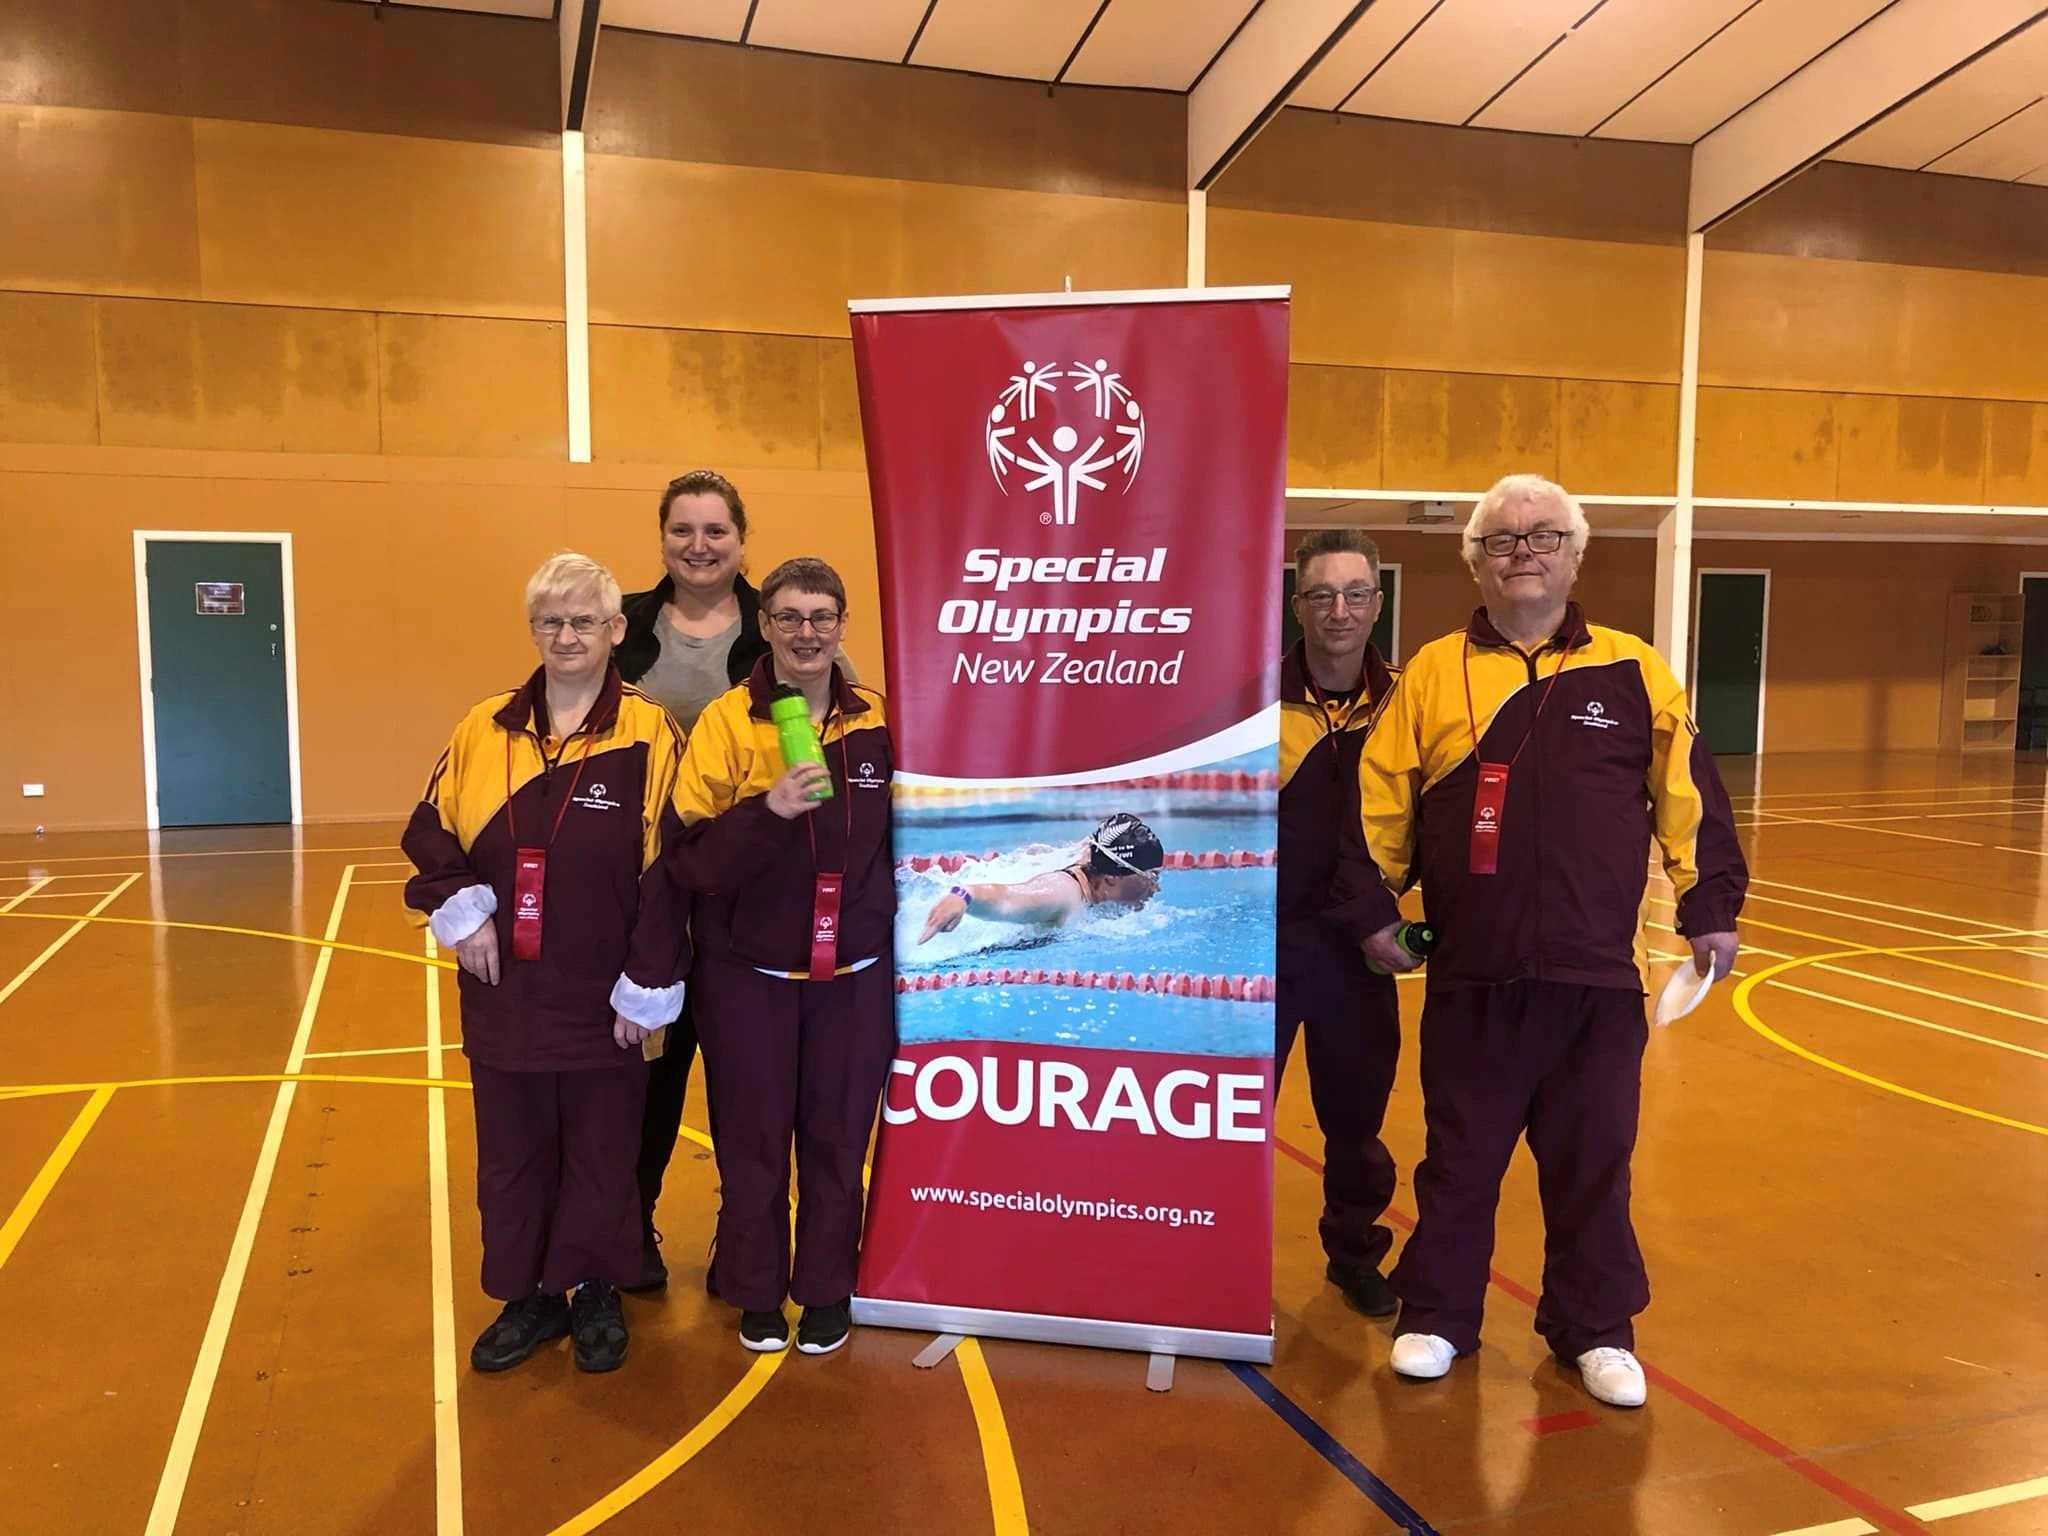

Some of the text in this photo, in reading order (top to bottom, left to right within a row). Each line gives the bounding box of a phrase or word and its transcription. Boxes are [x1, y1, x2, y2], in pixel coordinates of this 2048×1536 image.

[962, 547, 1168, 591] Special
[937, 599, 1193, 642] Olympics
[952, 650, 1185, 685] New Zealand
[882, 1055, 1267, 1142] COURAGE
[910, 1185, 1216, 1227] www.specialolympics.org.nz
